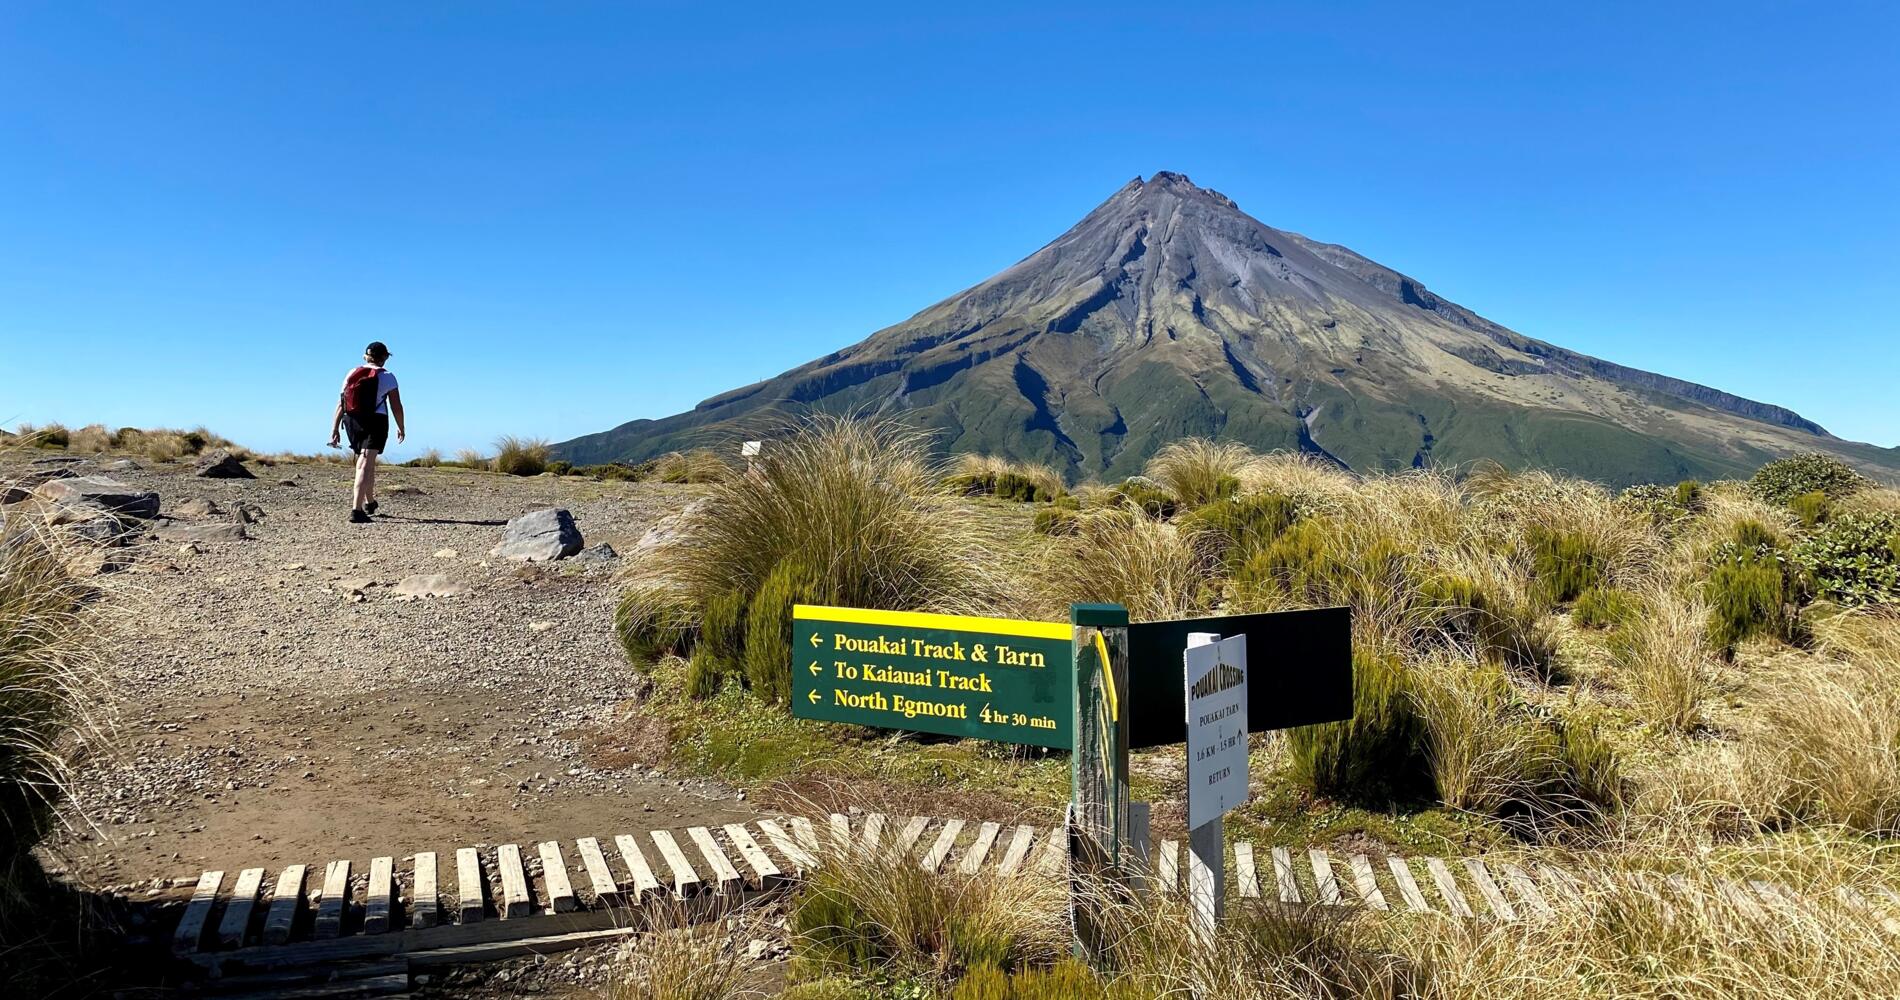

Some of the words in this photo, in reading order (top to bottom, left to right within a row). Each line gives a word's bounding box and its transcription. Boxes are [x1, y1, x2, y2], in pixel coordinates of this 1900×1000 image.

[834, 633, 907, 656] Pouakai
[911, 638, 967, 661] Track
[971, 643, 988, 663] &
[994, 645, 1046, 668] Tarn
[834, 661, 858, 680] To
[862, 664, 932, 687] Kaiauai
[937, 670, 993, 693] Track
[1191, 665, 1219, 701] POUAKAI
[1219, 663, 1244, 692] CROSSING
[834, 689, 888, 711] North
[892, 694, 968, 719] Egmont
[1011, 713, 1027, 727] 30
[1030, 715, 1057, 730] min
[1199, 708, 1225, 727] POUAKAI
[1226, 704, 1240, 717] TARN
[1206, 745, 1216, 758] KM
[1227, 736, 1236, 748] HR
[1209, 767, 1231, 785] RETURN
